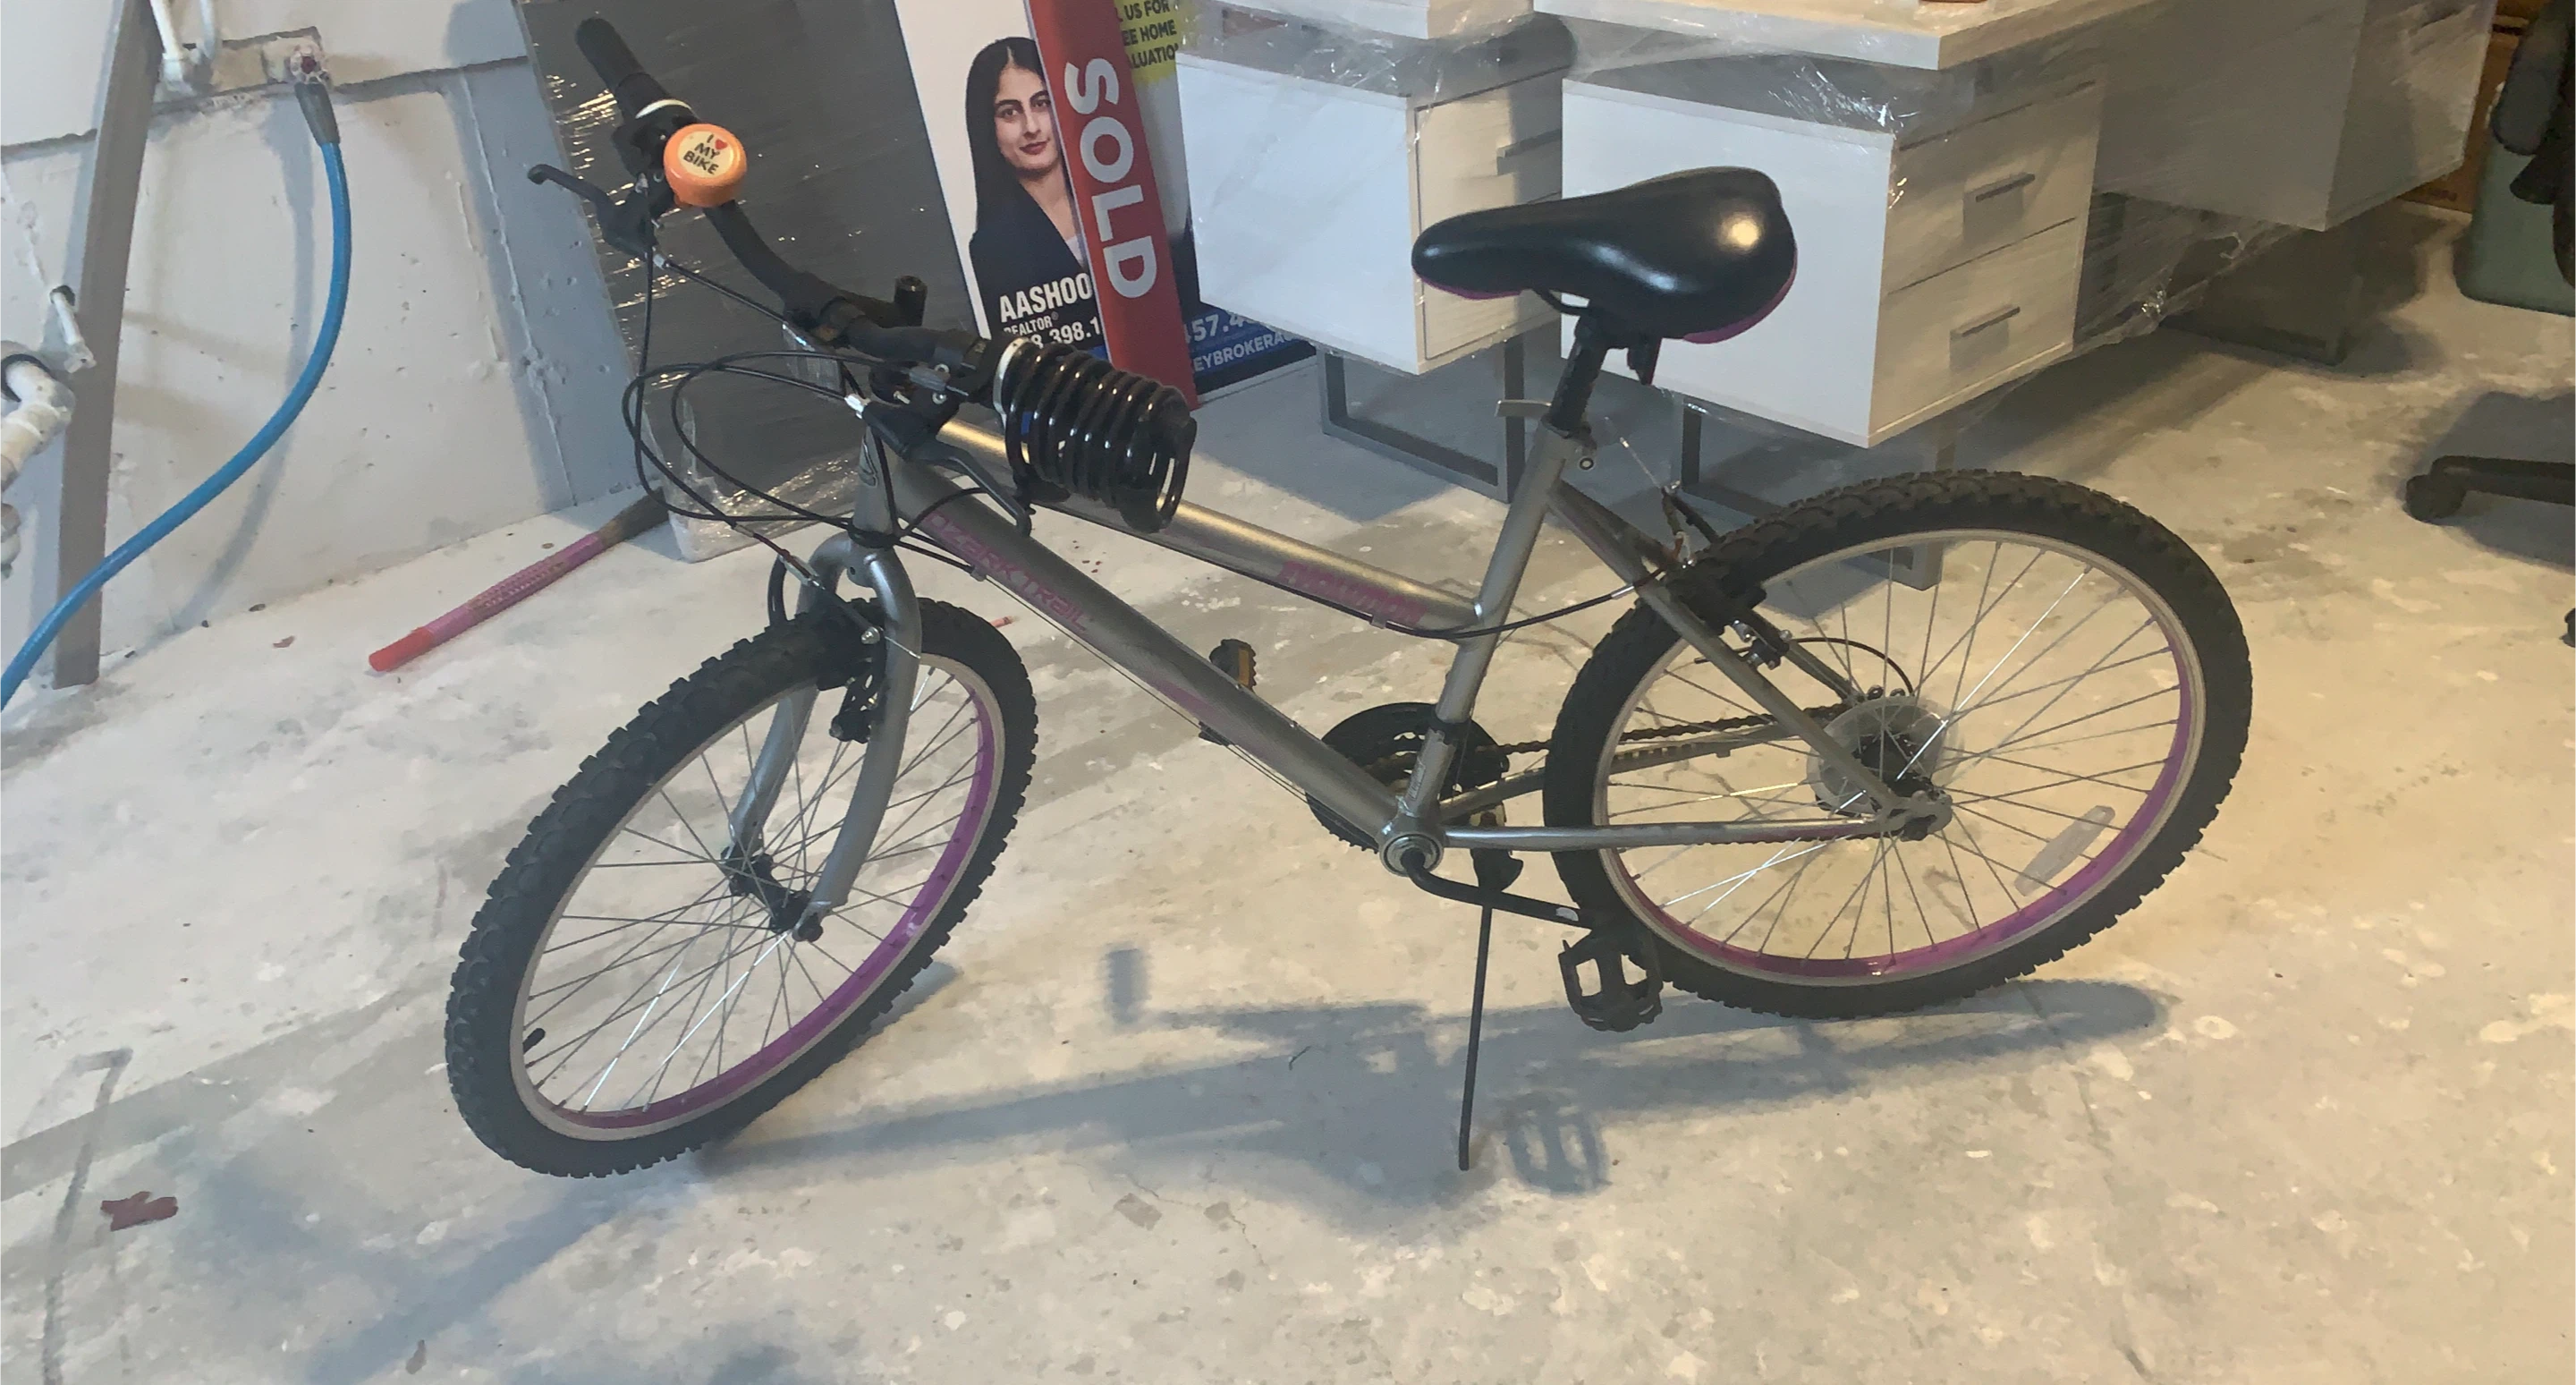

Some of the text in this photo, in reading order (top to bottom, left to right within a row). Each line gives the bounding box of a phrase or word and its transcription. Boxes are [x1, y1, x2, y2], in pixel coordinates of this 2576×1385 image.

[1124, 3, 1142, 21] US
[1144, 0, 1170, 17] FOR
[1140, 19, 1177, 42] HOME
[707, 134, 715, 143] I
[683, 150, 719, 175] BIKE
[694, 143, 720, 159] MY
[1064, 58, 1157, 298] SOLD
[999, 272, 1093, 323] AASHOO
